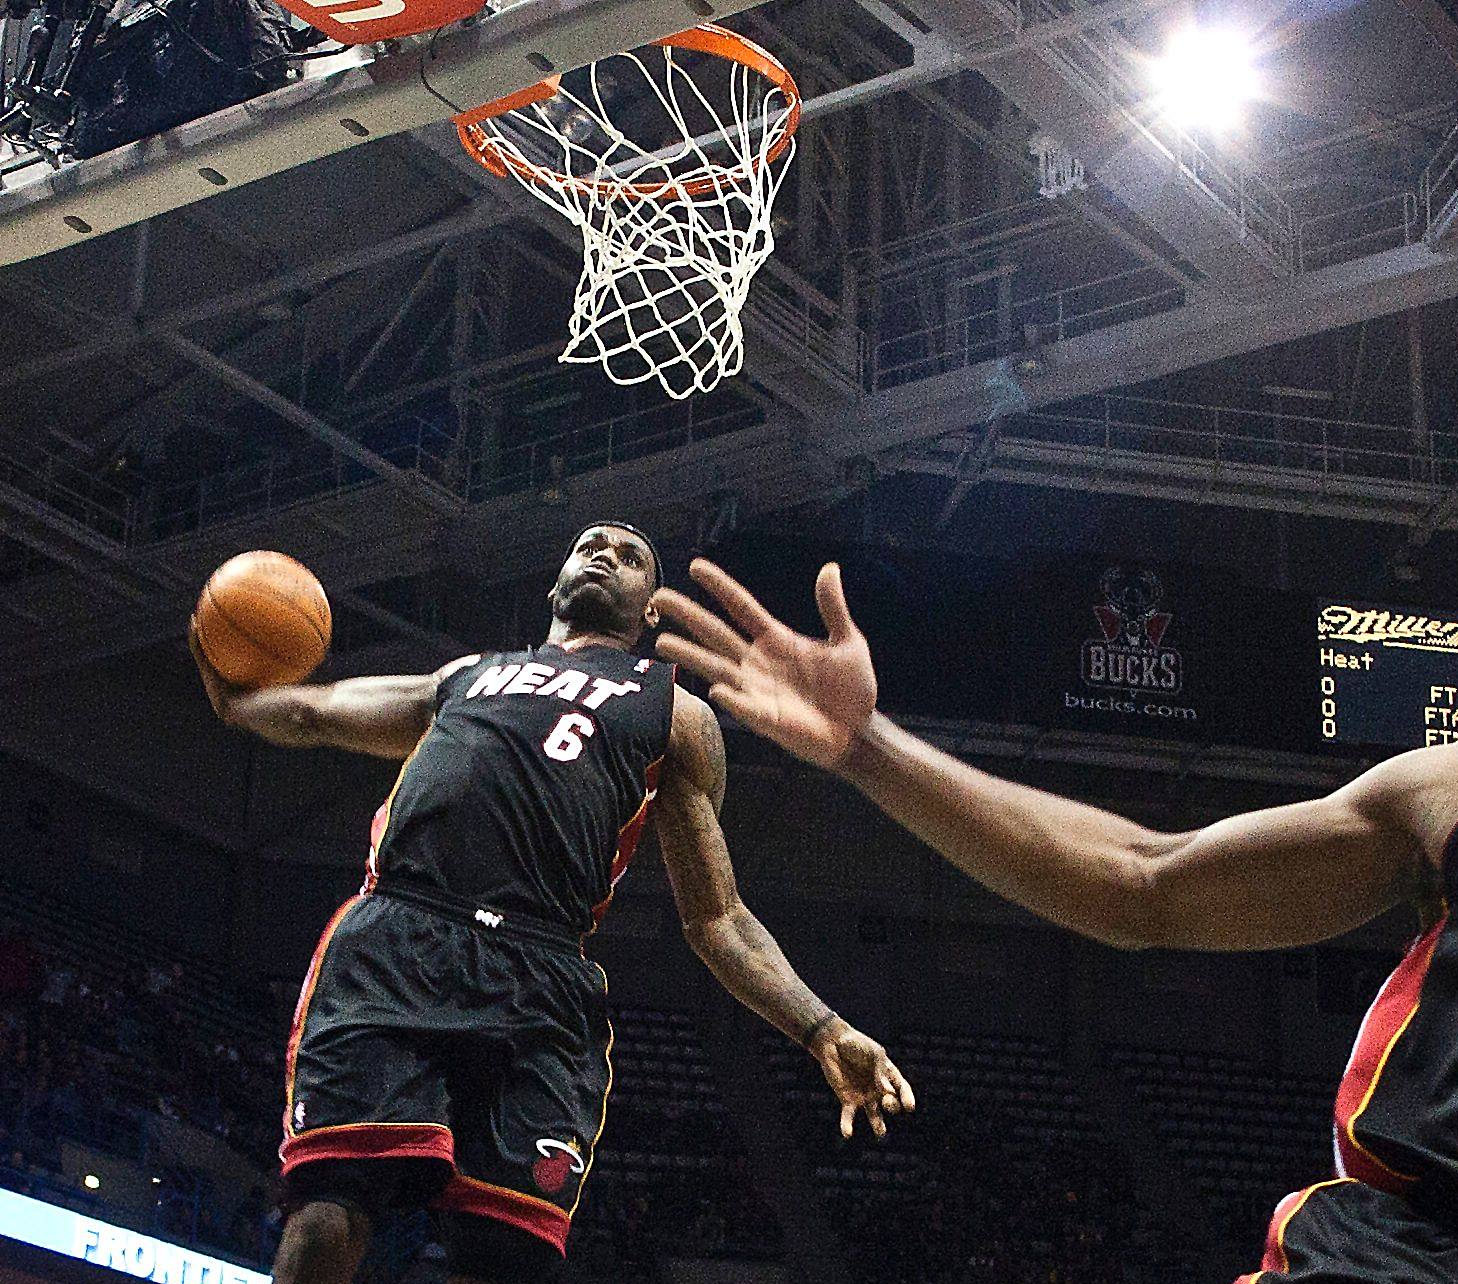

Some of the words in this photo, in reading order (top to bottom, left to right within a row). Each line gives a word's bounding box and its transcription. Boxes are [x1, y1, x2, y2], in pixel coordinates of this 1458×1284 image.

[1089, 646, 1176, 688] BUCKS
[1320, 648, 1374, 671] Heat
[465, 662, 642, 710] HEAT
[1321, 676, 1335, 695] 0
[1430, 685, 1458, 706] FT
[1064, 692, 1198, 720] bucks.com
[1322, 698, 1336, 718] 0
[542, 711, 596, 762] 6
[1322, 719, 1337, 738] 0
